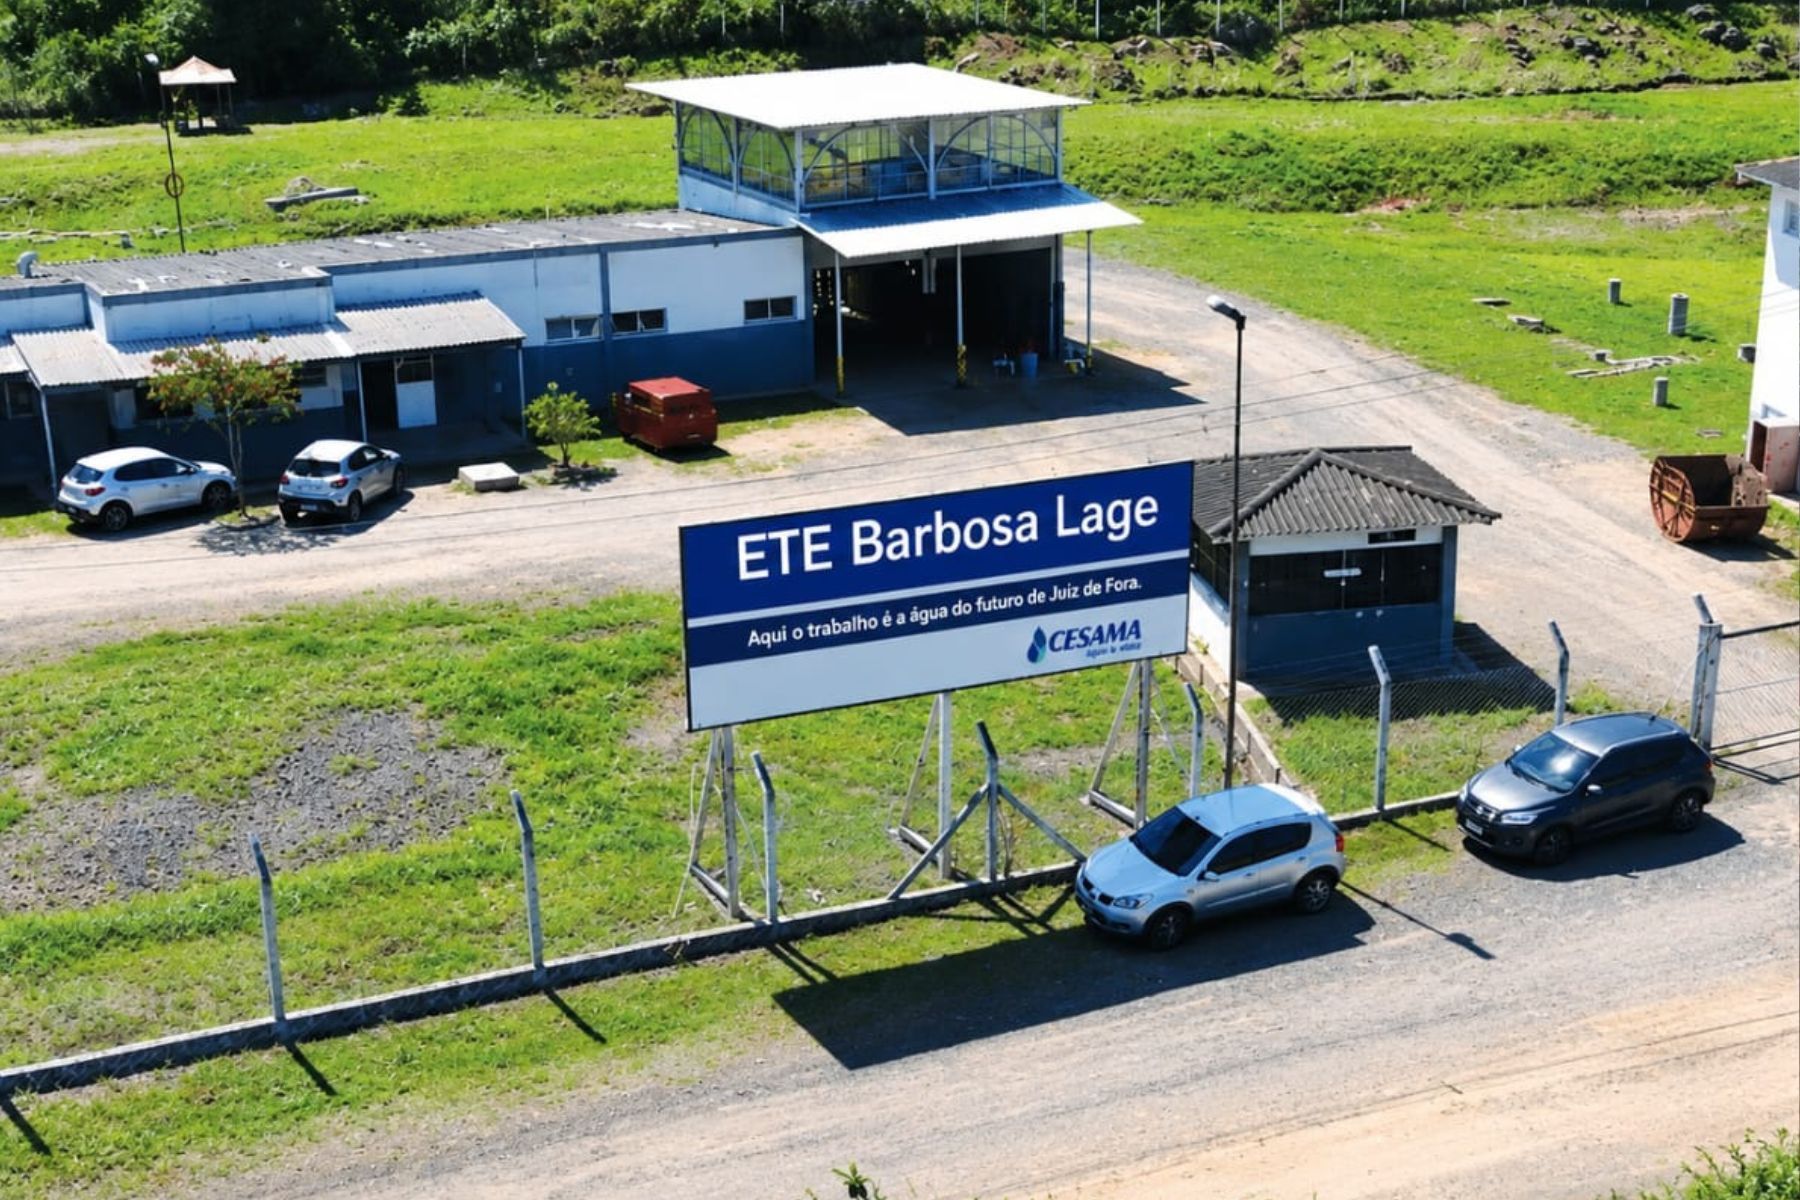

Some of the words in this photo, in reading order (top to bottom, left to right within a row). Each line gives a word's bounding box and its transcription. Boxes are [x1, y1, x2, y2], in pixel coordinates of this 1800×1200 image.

[737, 524, 833, 581] ETE
[852, 510, 1039, 566] Barbosa
[1056, 494, 1159, 542] Lage
[748, 625, 787, 649] Aqui
[792, 627, 804, 640] o
[807, 615, 878, 638] trabalho
[882, 610, 892, 627] é
[896, 612, 906, 625] a
[909, 606, 948, 626] água
[951, 599, 973, 617] do
[976, 595, 1024, 613] futuro
[1027, 588, 1046, 604] de
[1049, 583, 1080, 602] Juiz
[1082, 579, 1102, 597] de
[1105, 577, 1142, 593] Fora.
[1048, 619, 1142, 653] CESAMA
